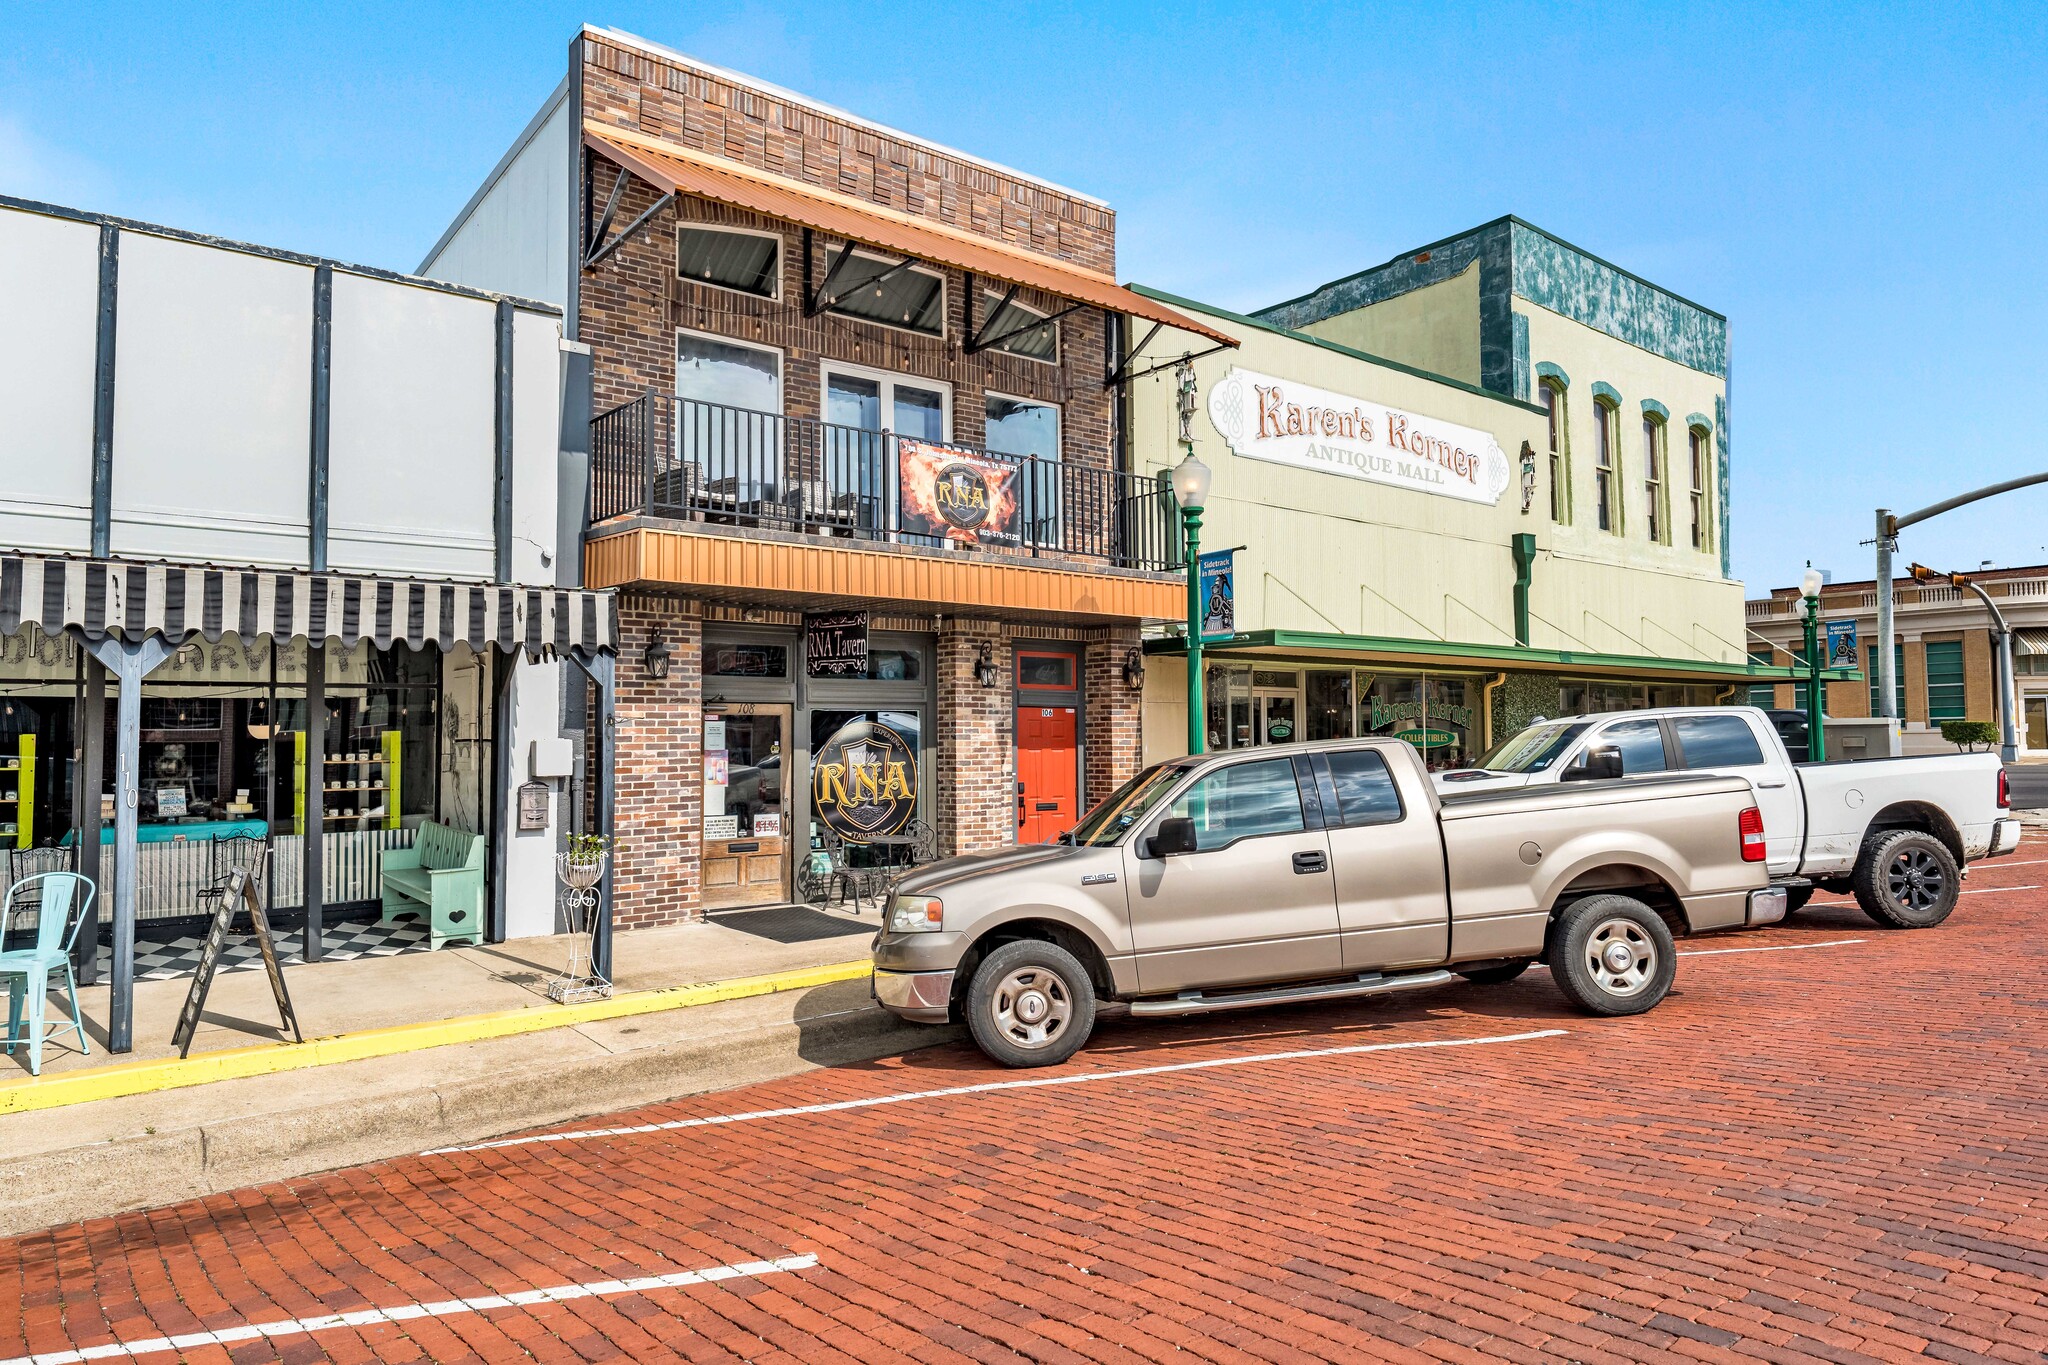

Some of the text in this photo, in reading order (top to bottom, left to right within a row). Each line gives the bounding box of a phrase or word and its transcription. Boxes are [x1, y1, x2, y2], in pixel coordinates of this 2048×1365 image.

[1254, 384, 1480, 485] Karen's Korner
[1305, 443, 1445, 485] ANTIQUE MALL
[937, 481, 988, 509] RNA
[1204, 559, 1229, 568] Sidetrack
[808, 631, 867, 658] RNA Tavern
[738, 703, 755, 714] 108
[1042, 709, 1053, 717] 106
[1370, 694, 1473, 731] Karen's Korner
[873, 727, 905, 753] EXPERIENCE
[1400, 733, 1449, 743] COLLECTIBLES
[120, 752, 138, 809] 110
[818, 761, 914, 808] RNA
